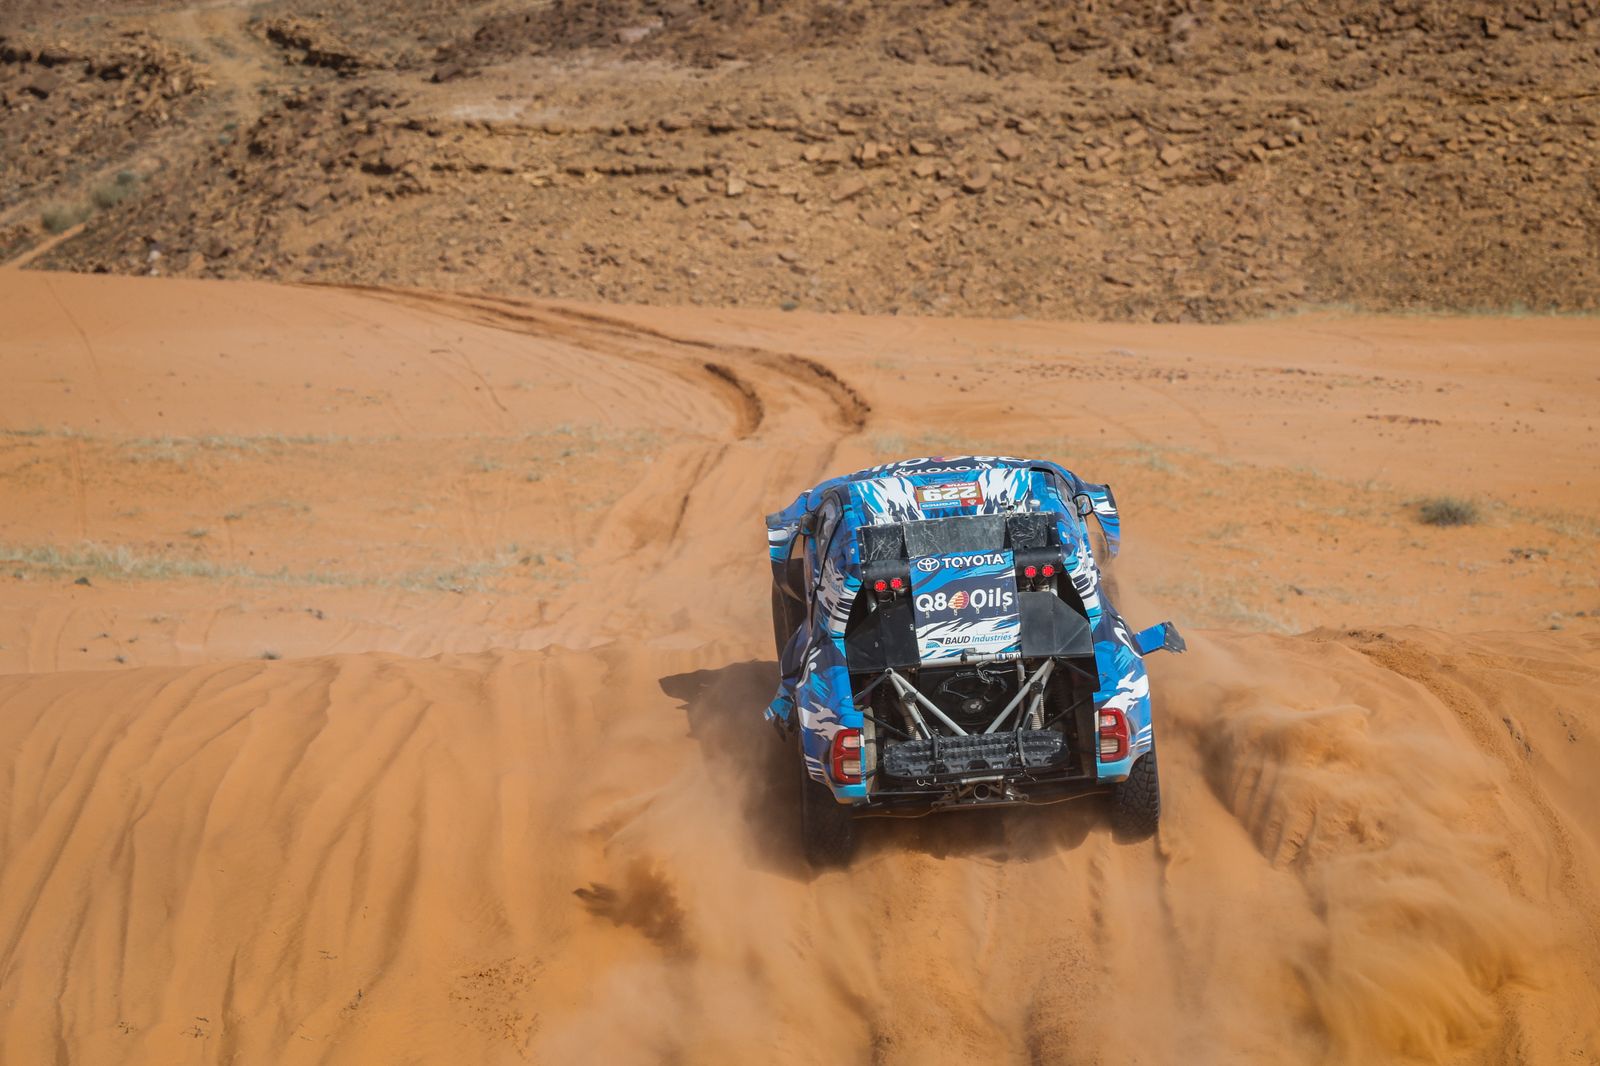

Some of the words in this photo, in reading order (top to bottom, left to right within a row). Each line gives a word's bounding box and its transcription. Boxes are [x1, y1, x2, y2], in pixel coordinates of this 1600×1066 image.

[900, 466, 980, 476] TOYOTA
[923, 485, 977, 501] 229
[942, 554, 1004, 568] TOYOTA
[916, 593, 947, 612] Q8
[970, 588, 1013, 608] Oils
[945, 636, 970, 645] BAUD
[972, 634, 1012, 643] Industries
